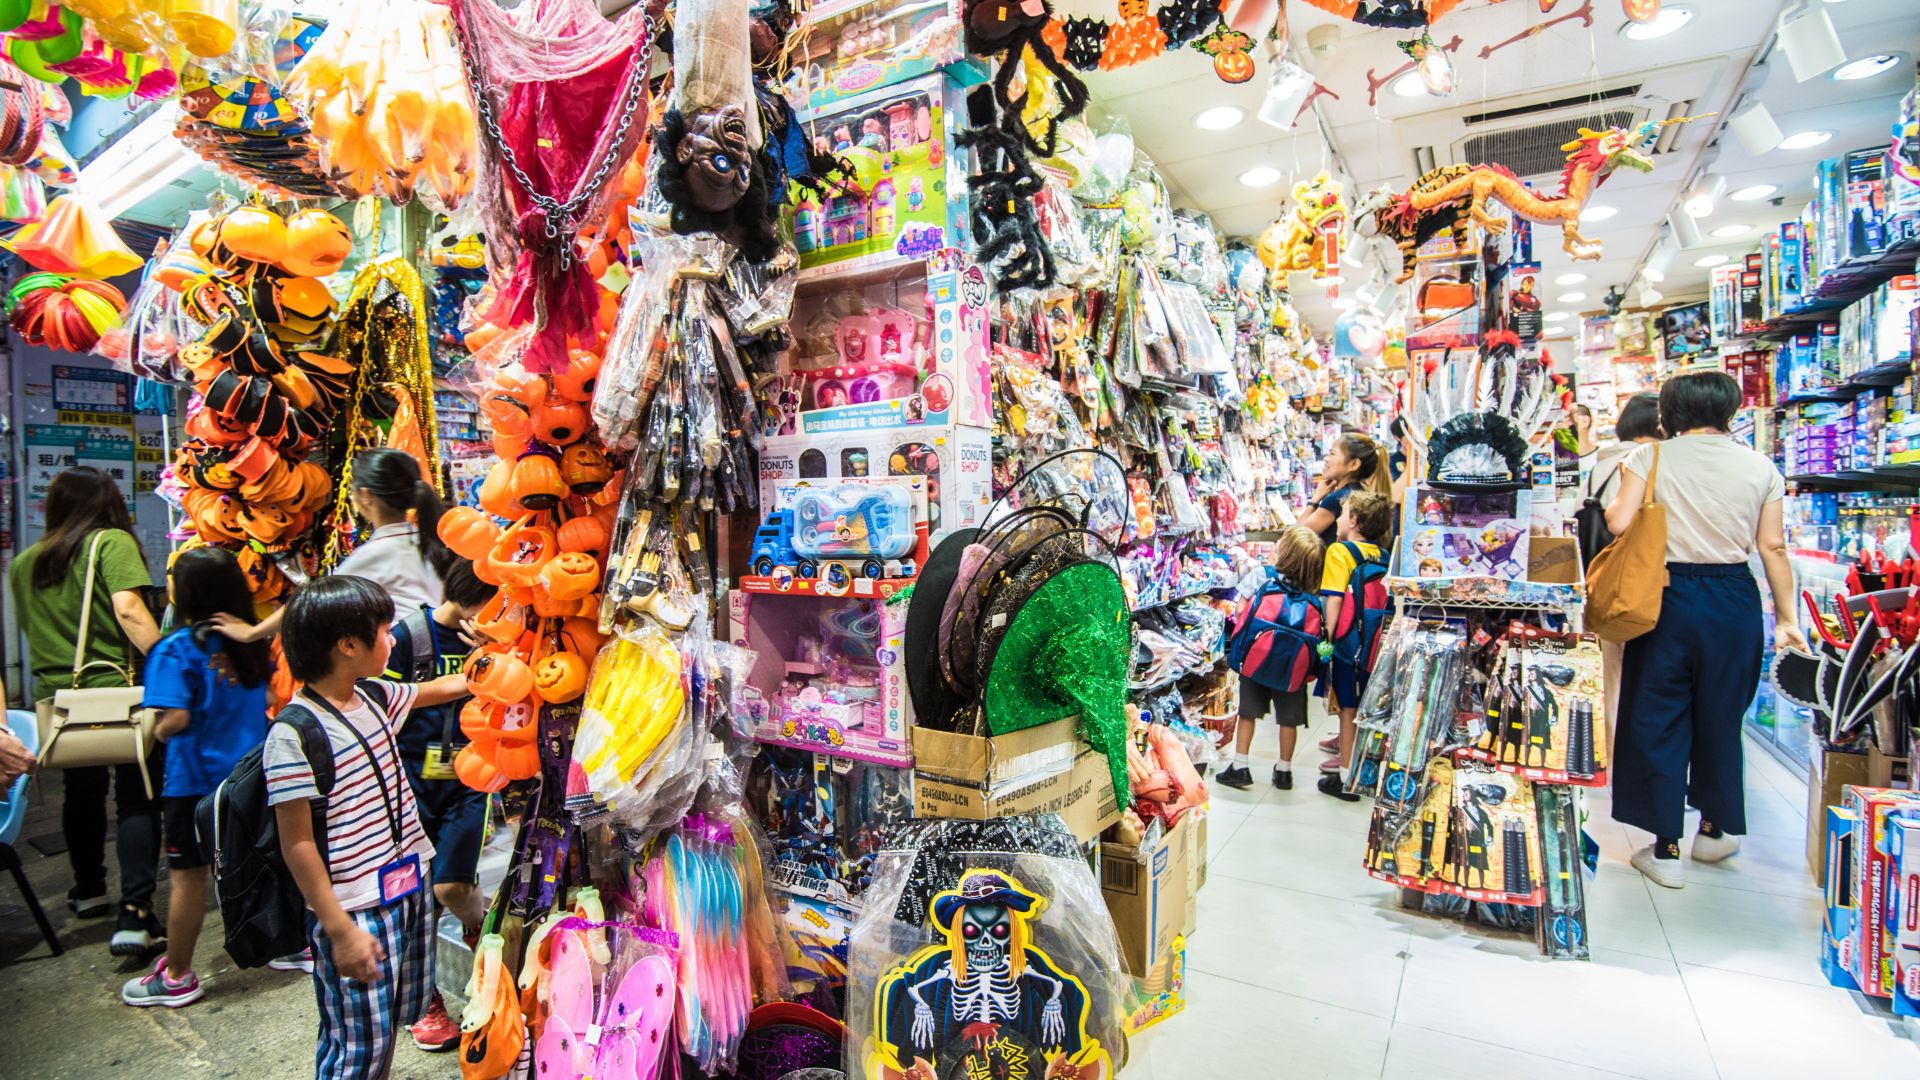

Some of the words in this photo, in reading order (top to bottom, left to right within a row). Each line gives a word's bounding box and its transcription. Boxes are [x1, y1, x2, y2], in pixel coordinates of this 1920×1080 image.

[961, 449, 987, 461] DONUTS
[760, 460, 794, 471] DONUTS
[961, 462, 979, 472] SHOP
[760, 471, 783, 480] SHOP
[996, 775, 1058, 807] E0490AS04-LCN
[927, 803, 937, 811] Pcs
[1003, 806, 1016, 816] Pcs
